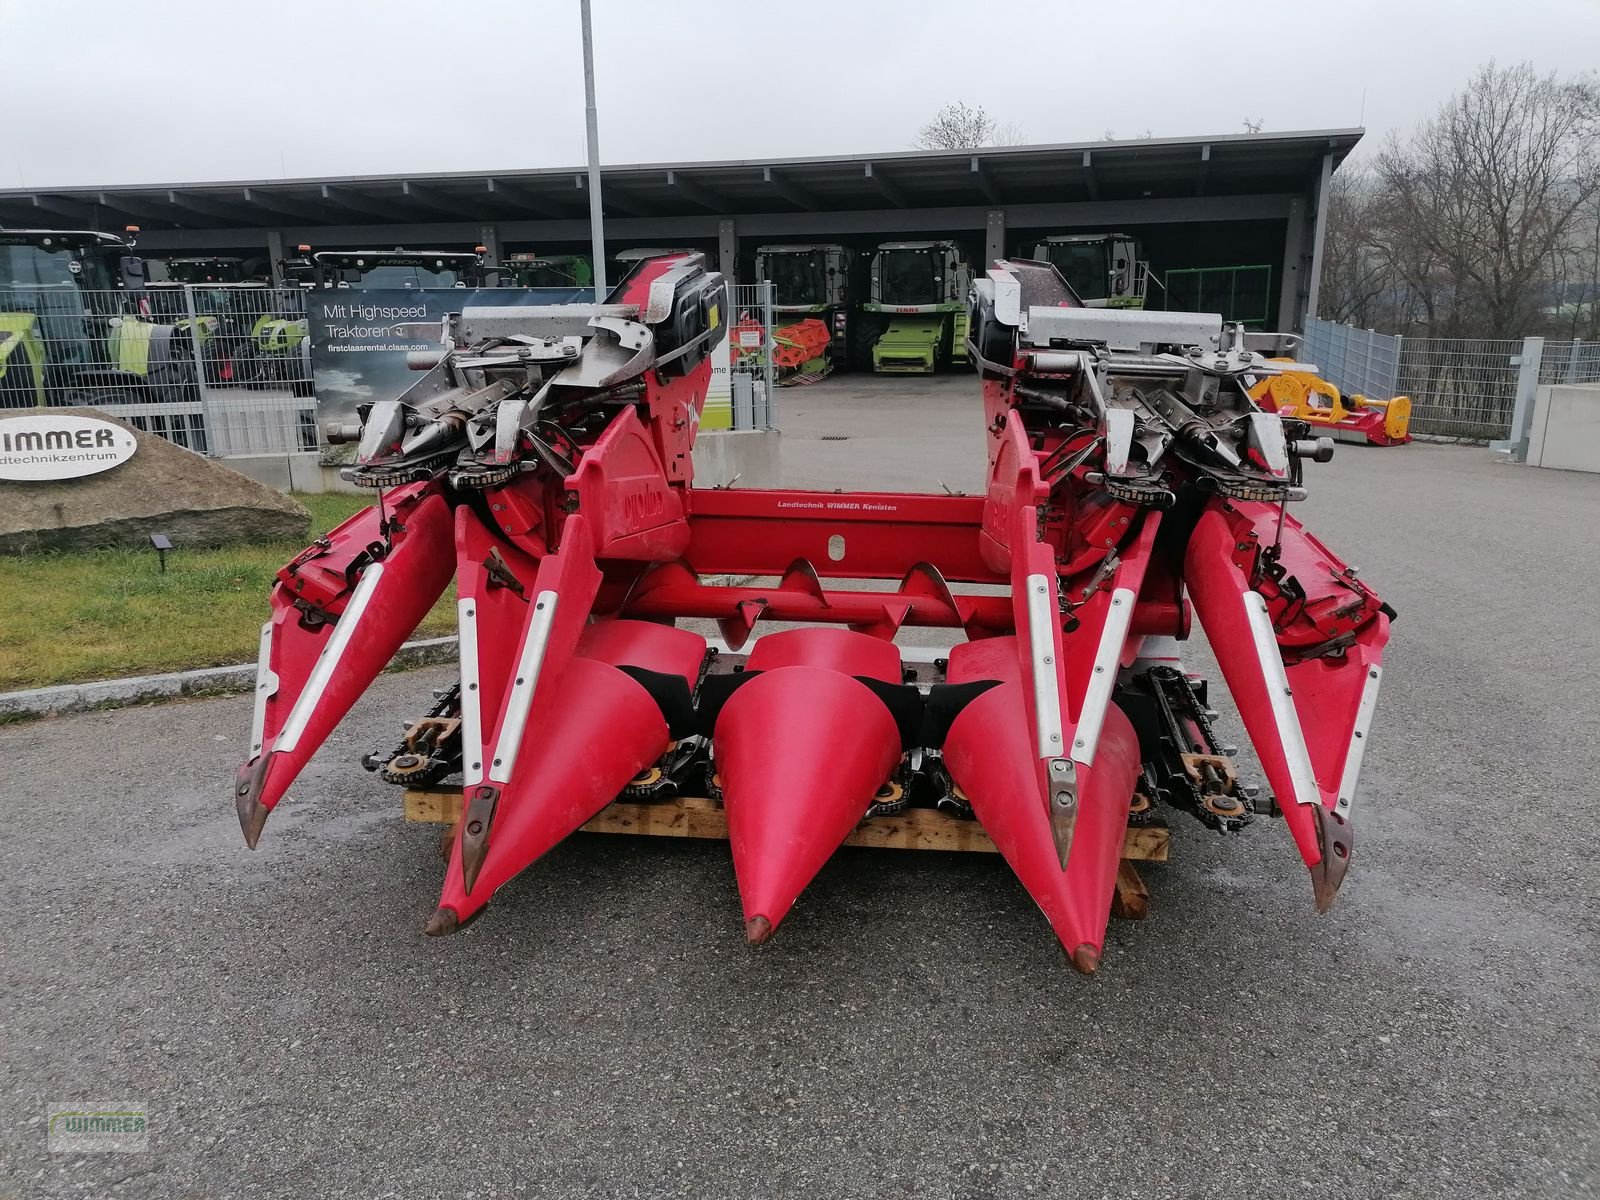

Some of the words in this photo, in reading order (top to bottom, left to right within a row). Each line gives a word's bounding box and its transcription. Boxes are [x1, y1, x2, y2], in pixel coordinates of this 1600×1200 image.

[324, 305, 346, 318] Mit
[350, 304, 426, 320] Highspeed
[325, 325, 390, 338] Traktoren
[328, 344, 428, 352] firstclaasrental.claas.com
[778, 501, 824, 509] Landtechnik
[827, 502, 860, 510] WIMMER
